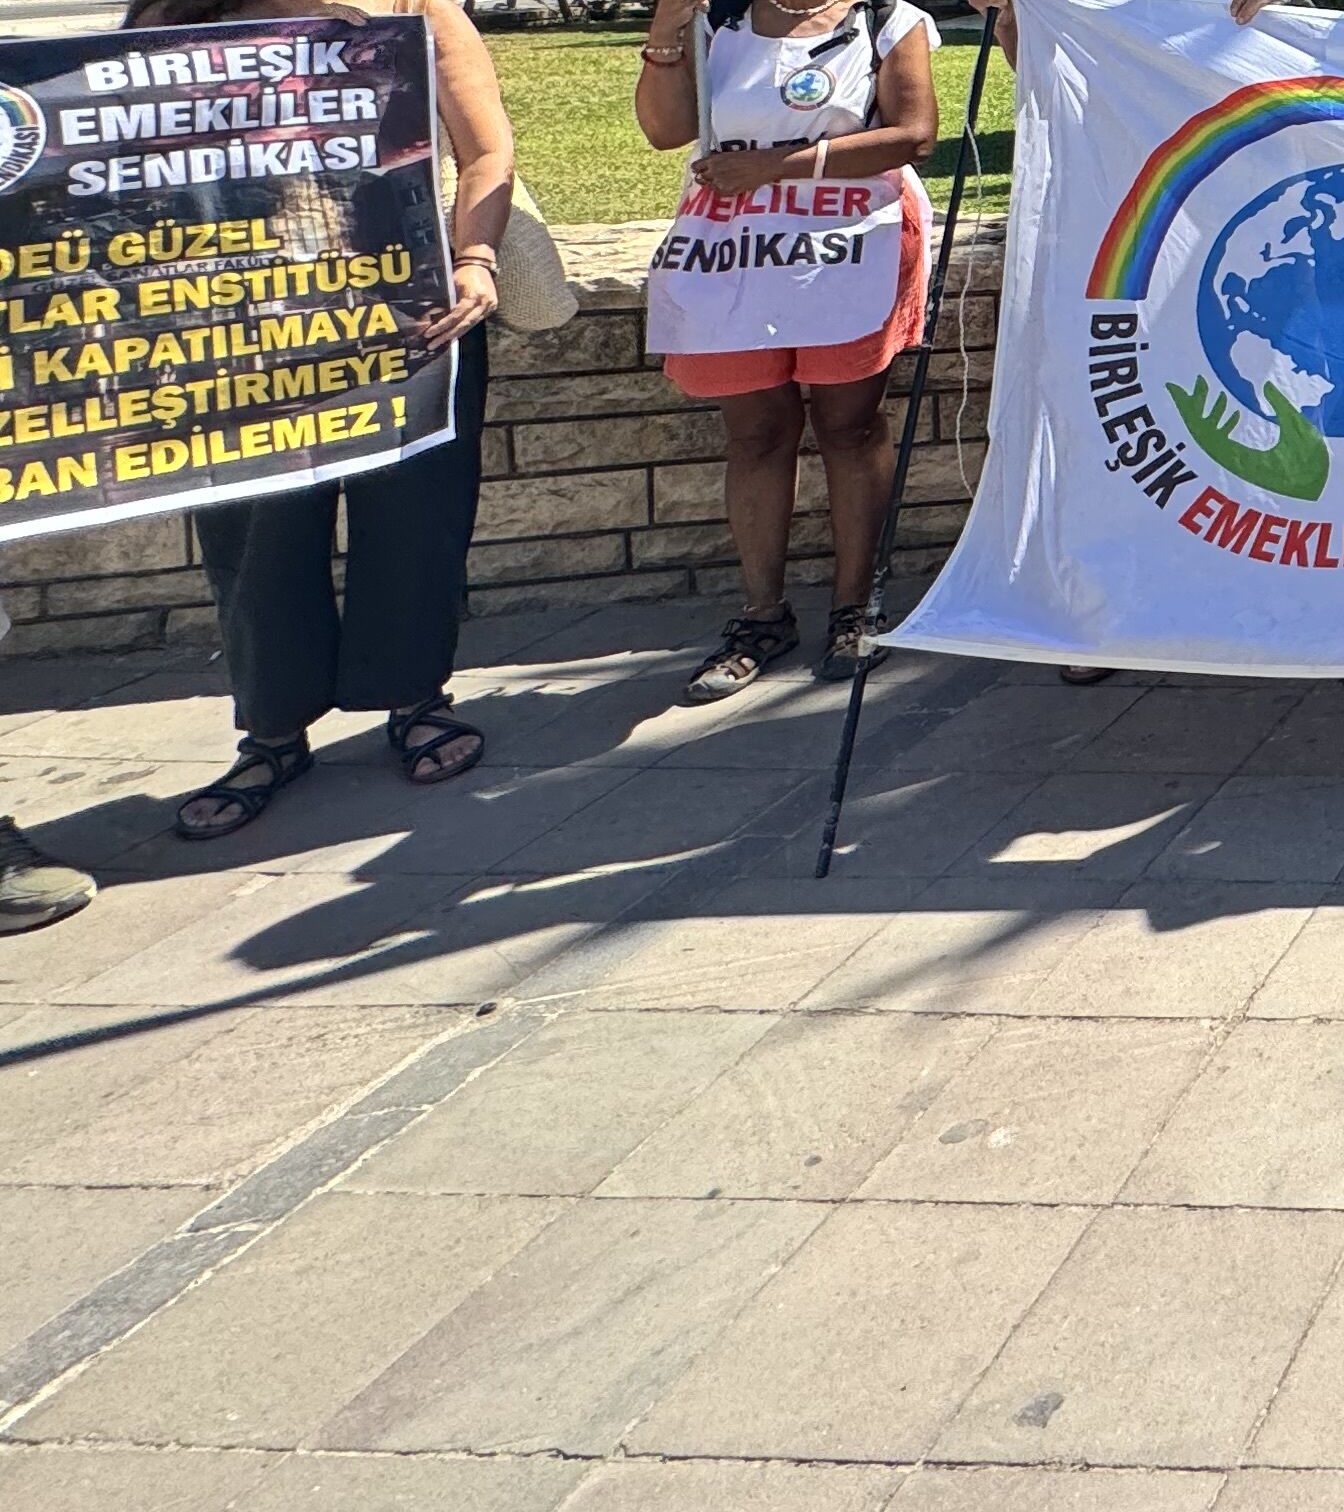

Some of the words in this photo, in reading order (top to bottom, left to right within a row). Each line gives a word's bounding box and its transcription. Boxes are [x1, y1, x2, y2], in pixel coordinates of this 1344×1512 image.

[84, 36, 350, 94] BİRLEŞİK
[60, 86, 379, 147] EMEKLİLER
[67, 133, 379, 197] SENDİKASI
[107, 218, 281, 267] GÜZEL
[651, 226, 865, 273] SENDİKASI
[138, 244, 412, 317] ENSTİTÜSÜ
[33, 303, 399, 386] KAPATILMAYA
[115, 403, 383, 482] EDİLEMEZ
[392, 396, 408, 428] !
[1088, 312, 1199, 509] BİRLEŞİK
